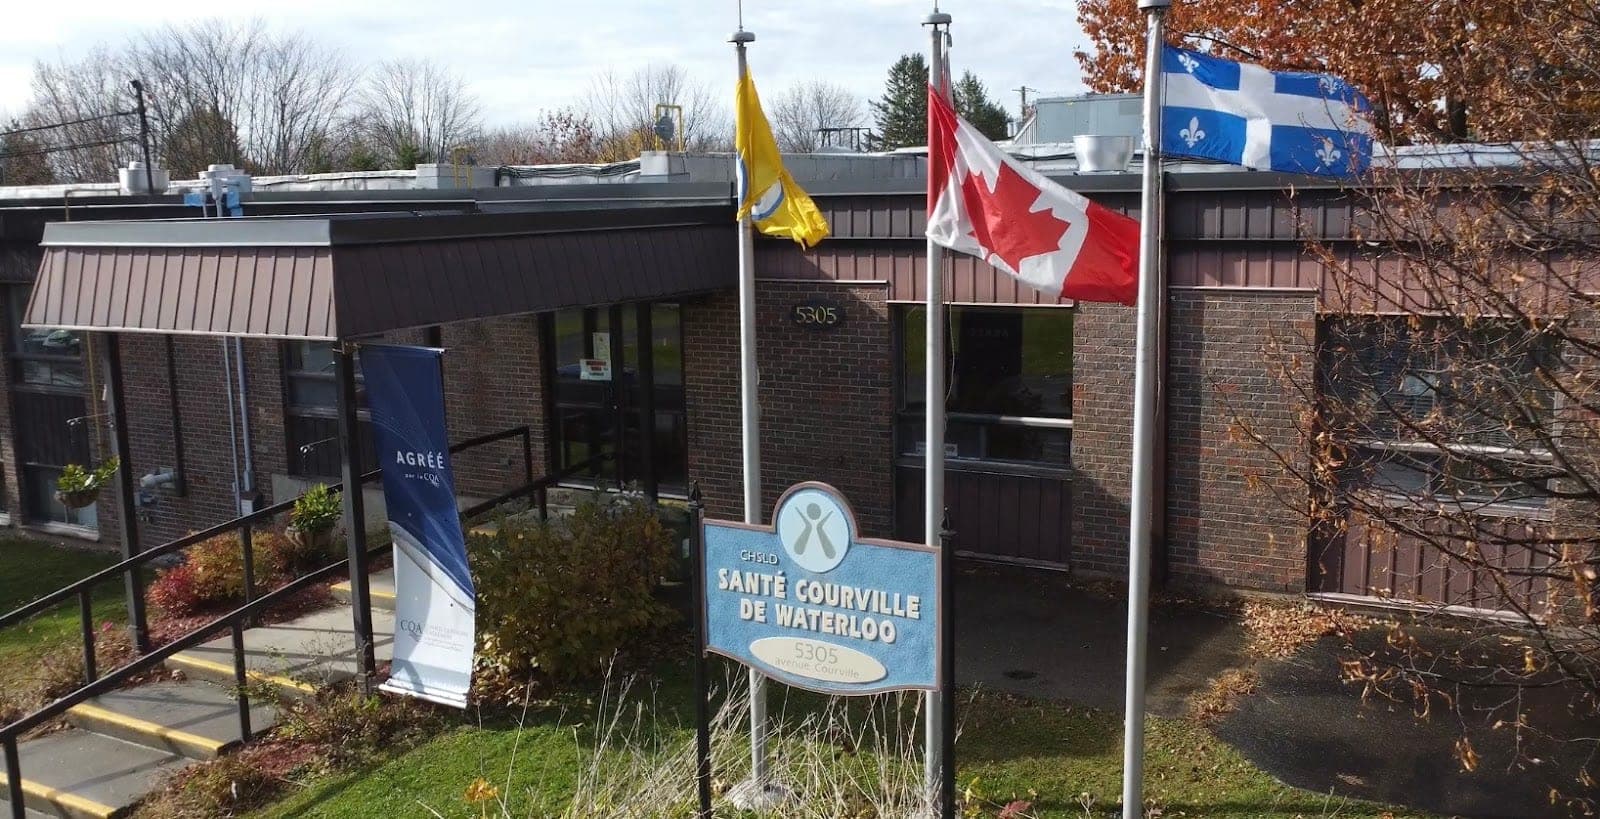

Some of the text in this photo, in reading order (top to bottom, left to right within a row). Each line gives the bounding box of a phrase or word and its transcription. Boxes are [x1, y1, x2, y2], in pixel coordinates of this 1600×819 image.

[796, 306, 837, 324] 5305
[396, 451, 445, 470] AGRÉÉ
[424, 472, 440, 484] CQA
[740, 550, 778, 565] CHSLD
[718, 568, 921, 620] SANTÉ COURVILLE
[400, 619, 424, 634] CQA
[740, 598, 897, 644] DE WATERLOO
[794, 642, 838, 665] 5305
[775, 657, 860, 679] avenue Courville
